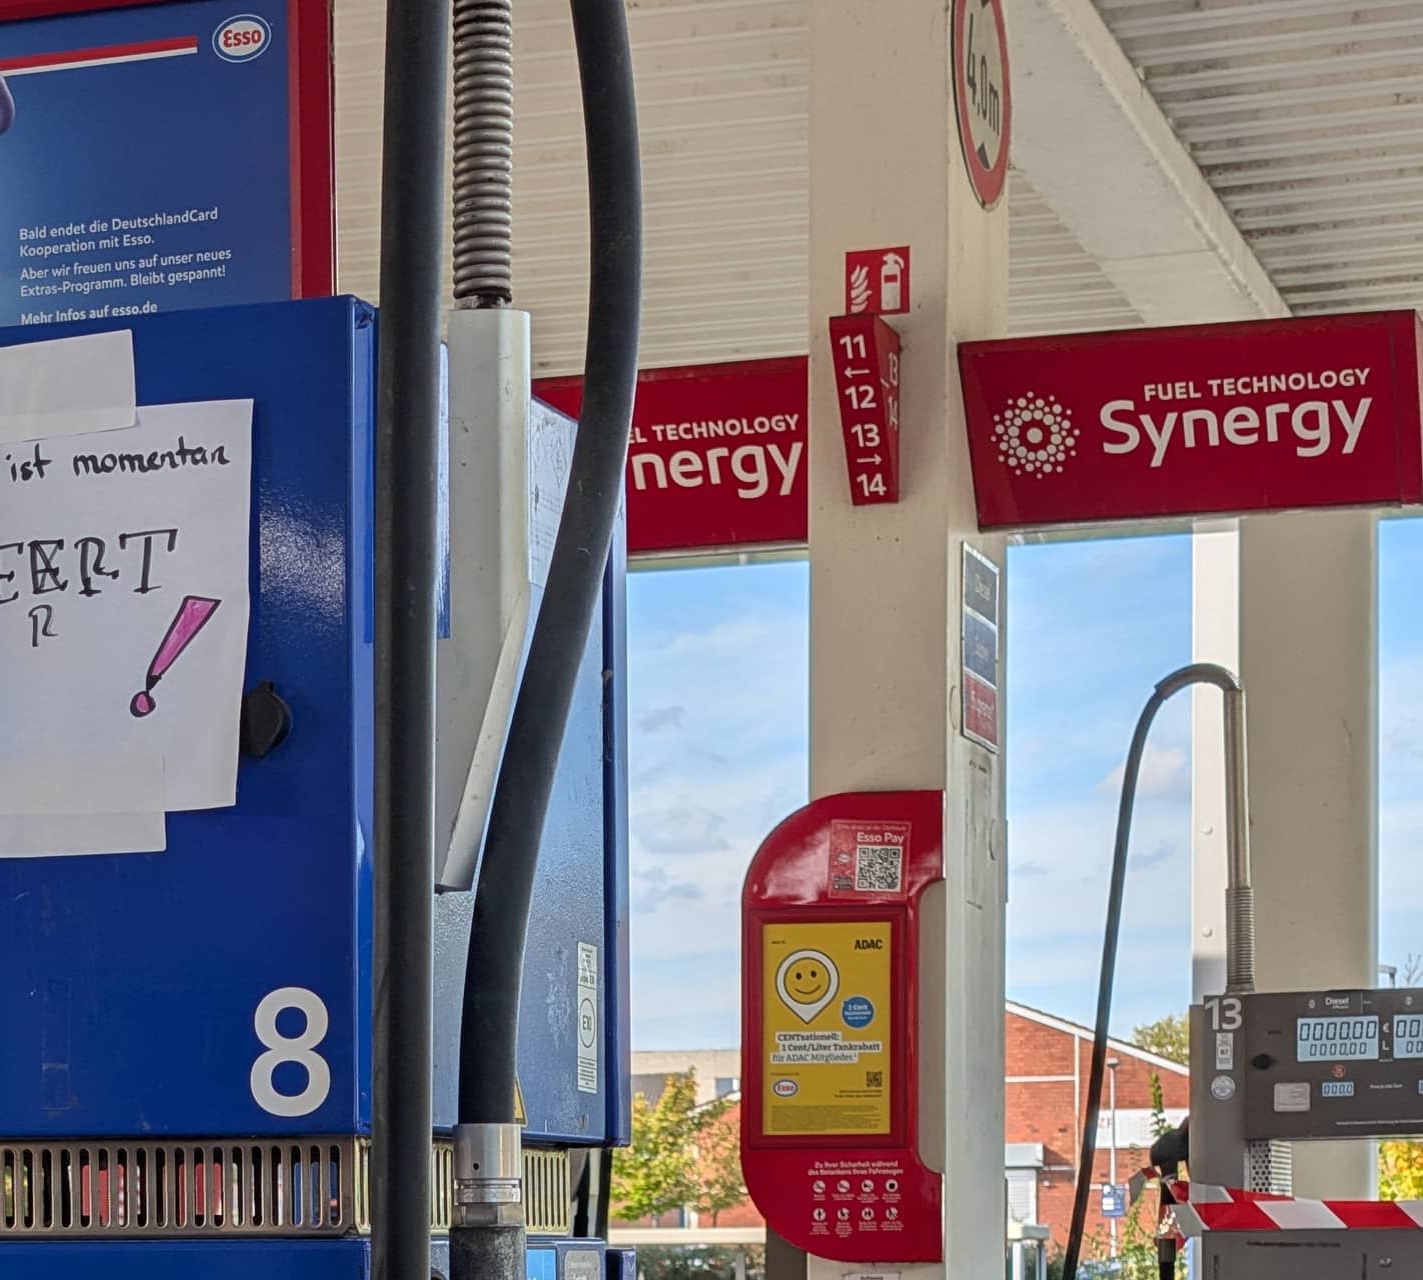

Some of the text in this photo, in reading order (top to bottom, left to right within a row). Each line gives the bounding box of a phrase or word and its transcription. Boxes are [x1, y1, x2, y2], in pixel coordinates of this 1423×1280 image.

[223, 29, 262, 48] Esso
[19, 207, 218, 241] Bald endet die DeutschlandCard
[19, 233, 155, 258] Kooperation mit Esso.
[20, 249, 232, 281] Aber wir freuen uns auf unser neues
[21, 265, 226, 298] Extras-Programm. Bleibt gespannt!
[21, 301, 158, 325] Mehr Infos auf esso.de
[840, 334, 866, 359] 11
[1144, 367, 1371, 402] FUEL TECHNOLOGY
[845, 385, 877, 410] 12
[627, 414, 800, 445] EL TECHNOLOGY
[851, 423, 881, 448] 13
[1099, 397, 1372, 468] Synergy
[6, 443, 52, 483] ist
[73, 436, 231, 476] momentan
[631, 442, 803, 499] nergy
[857, 473, 887, 497] 14
[857, 832, 905, 845] Esso Pay
[854, 938, 883, 950] ADAC
[1204, 998, 1243, 1030] 13
[1325, 997, 1349, 1006] Diesel
[250, 986, 331, 1117] 8
[772, 1054, 784, 1062] für
[786, 1053, 809, 1062] ADAC
[787, 1043, 832, 1052] Cent/Liter
[833, 1042, 880, 1052] Tankrabatt
[1382, 1040, 1390, 1051] L
[839, 1160, 870, 1168] Sicherheit
[871, 1160, 898, 1168] während
